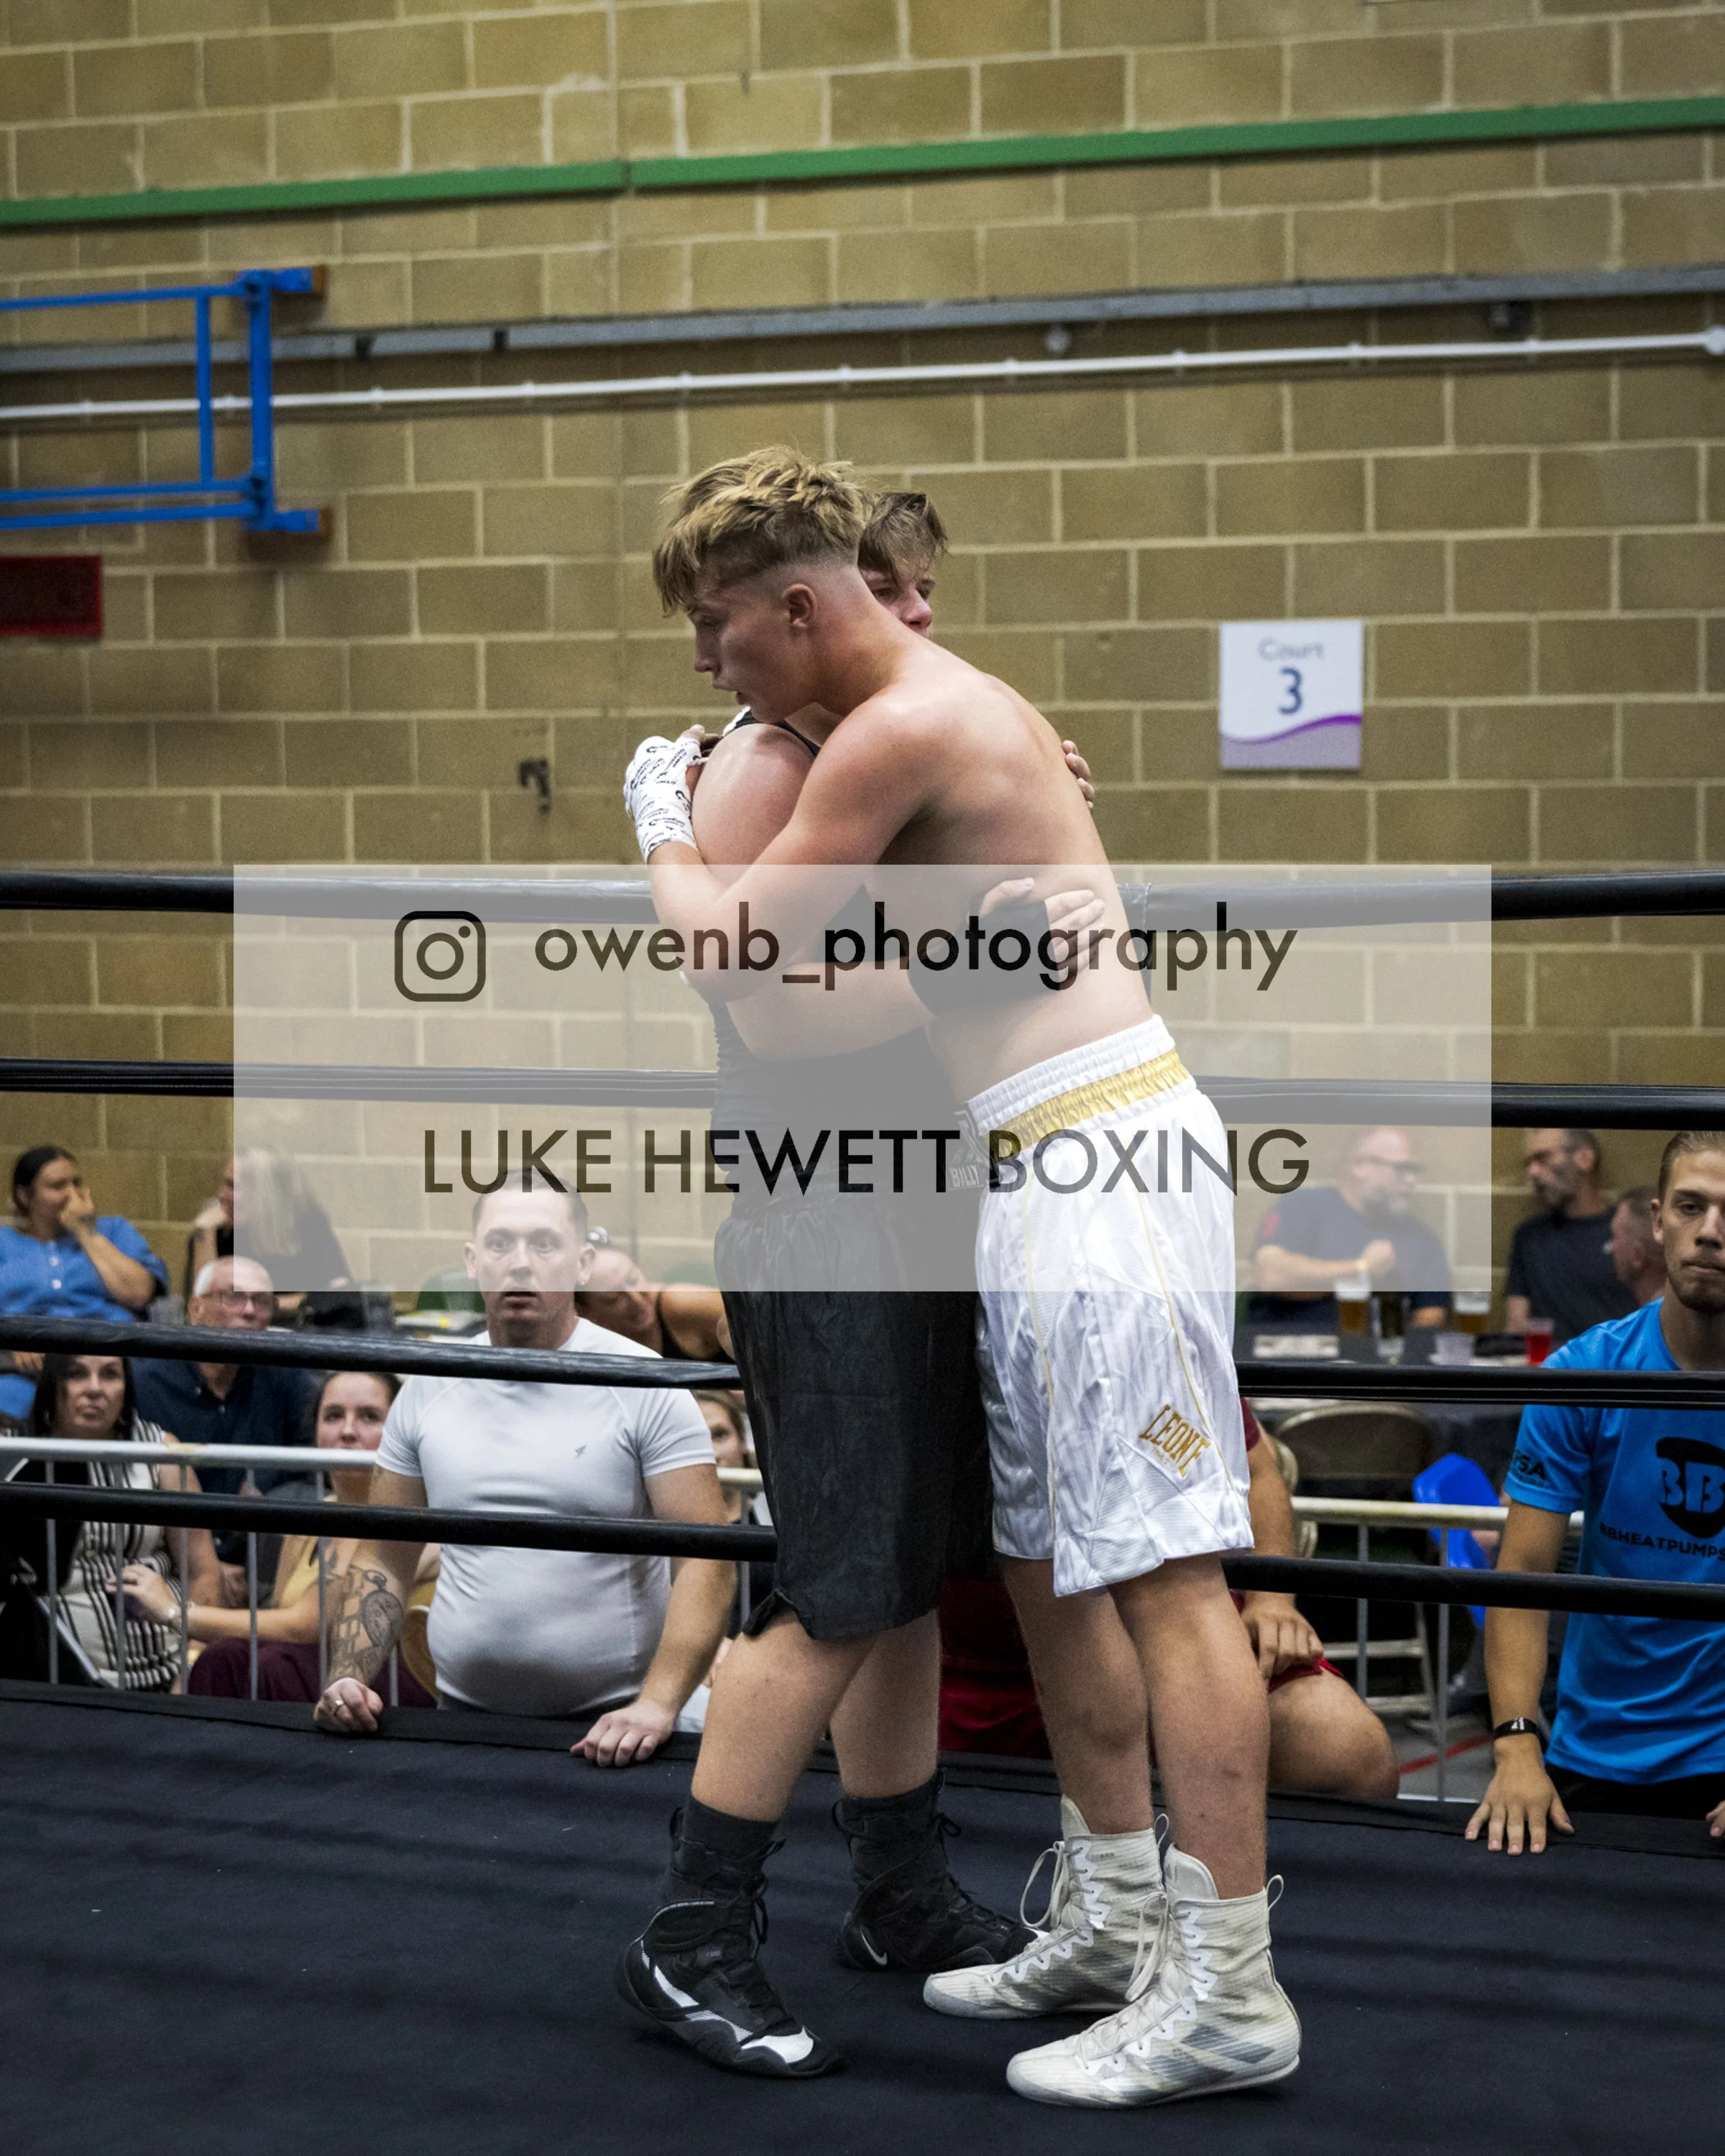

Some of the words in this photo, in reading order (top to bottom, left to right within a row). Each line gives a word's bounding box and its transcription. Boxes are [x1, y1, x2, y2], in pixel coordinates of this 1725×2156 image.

[1279, 666, 1303, 715] 3
[949, 1164, 980, 1187] BILLY
[1138, 1404, 1211, 1478] LEONE
